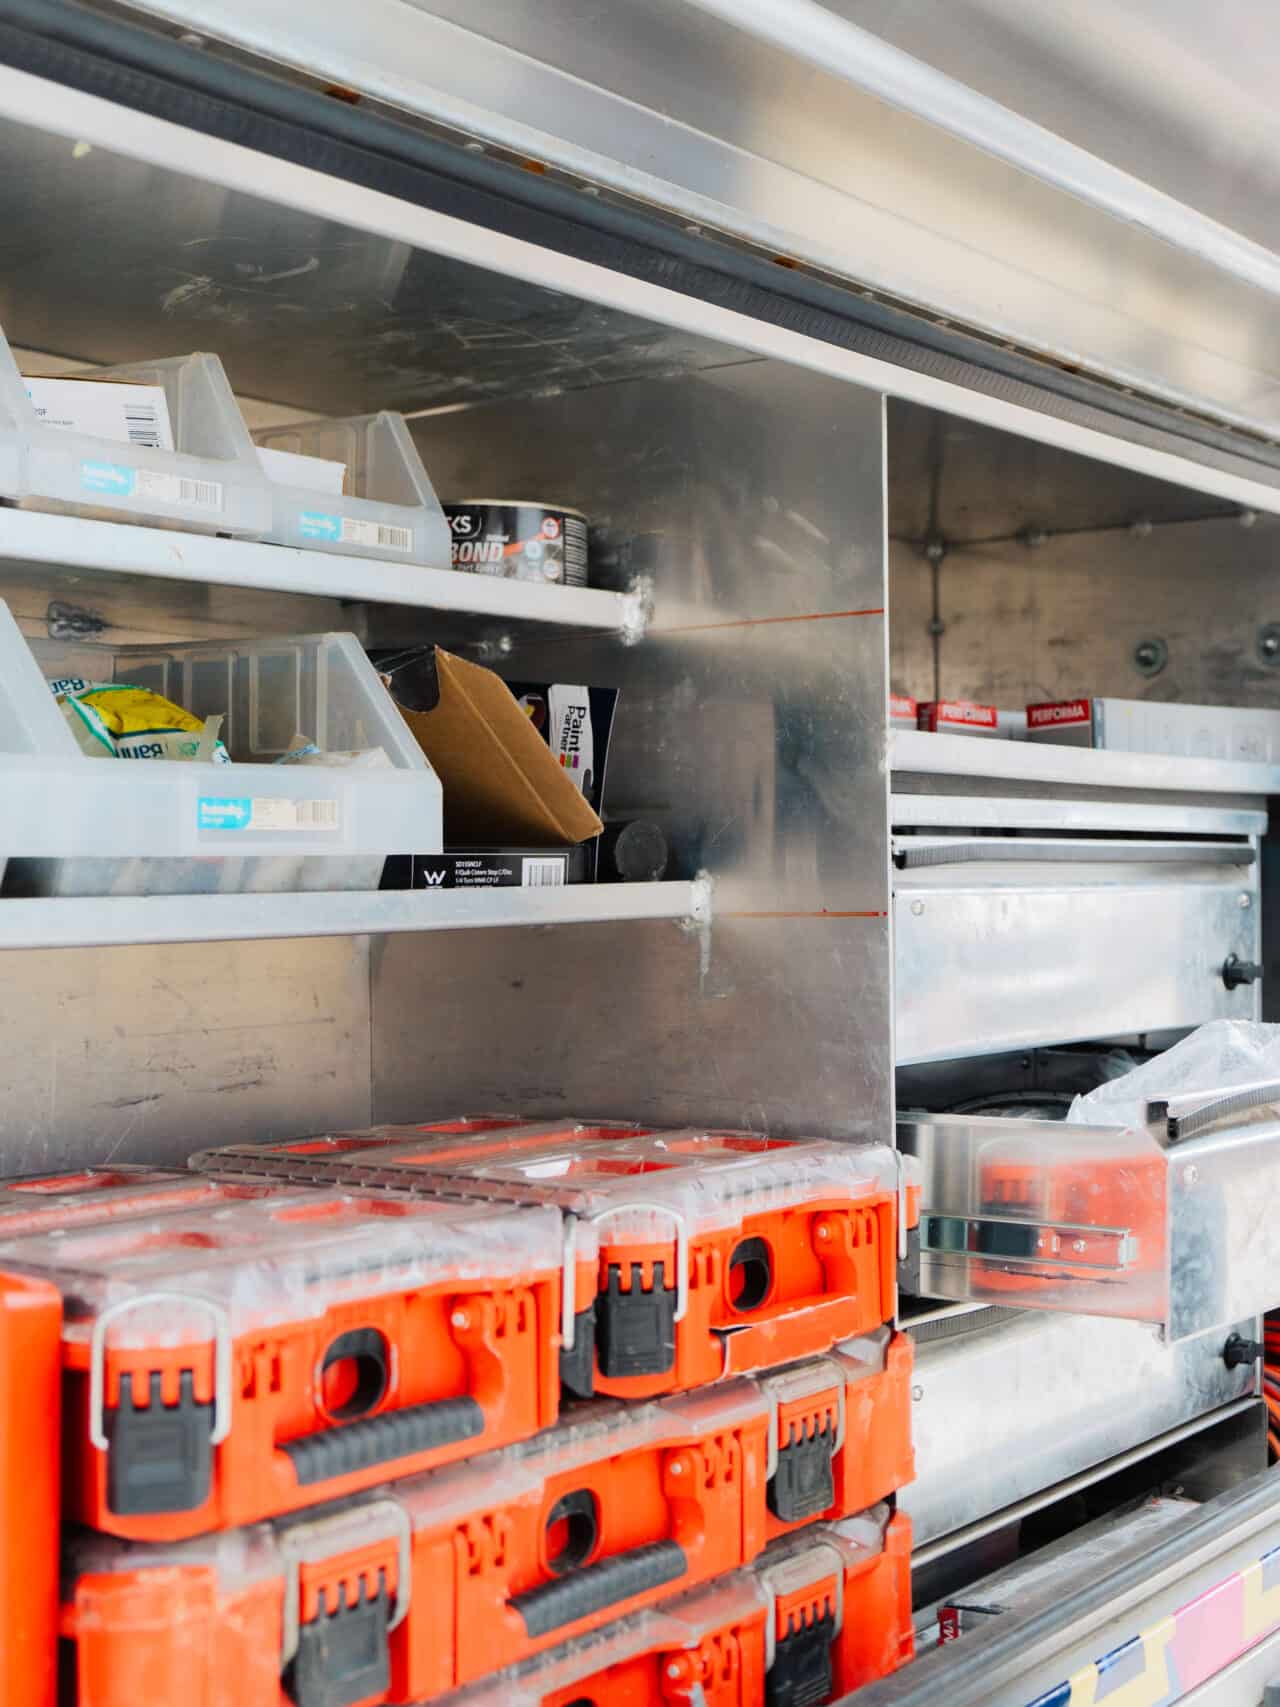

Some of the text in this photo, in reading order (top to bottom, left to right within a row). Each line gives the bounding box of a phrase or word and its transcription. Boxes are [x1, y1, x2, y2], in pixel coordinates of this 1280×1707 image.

[1031, 705, 1085, 723] PERFORMA
[568, 705, 587, 752] Paint
[423, 870, 447, 885] W
